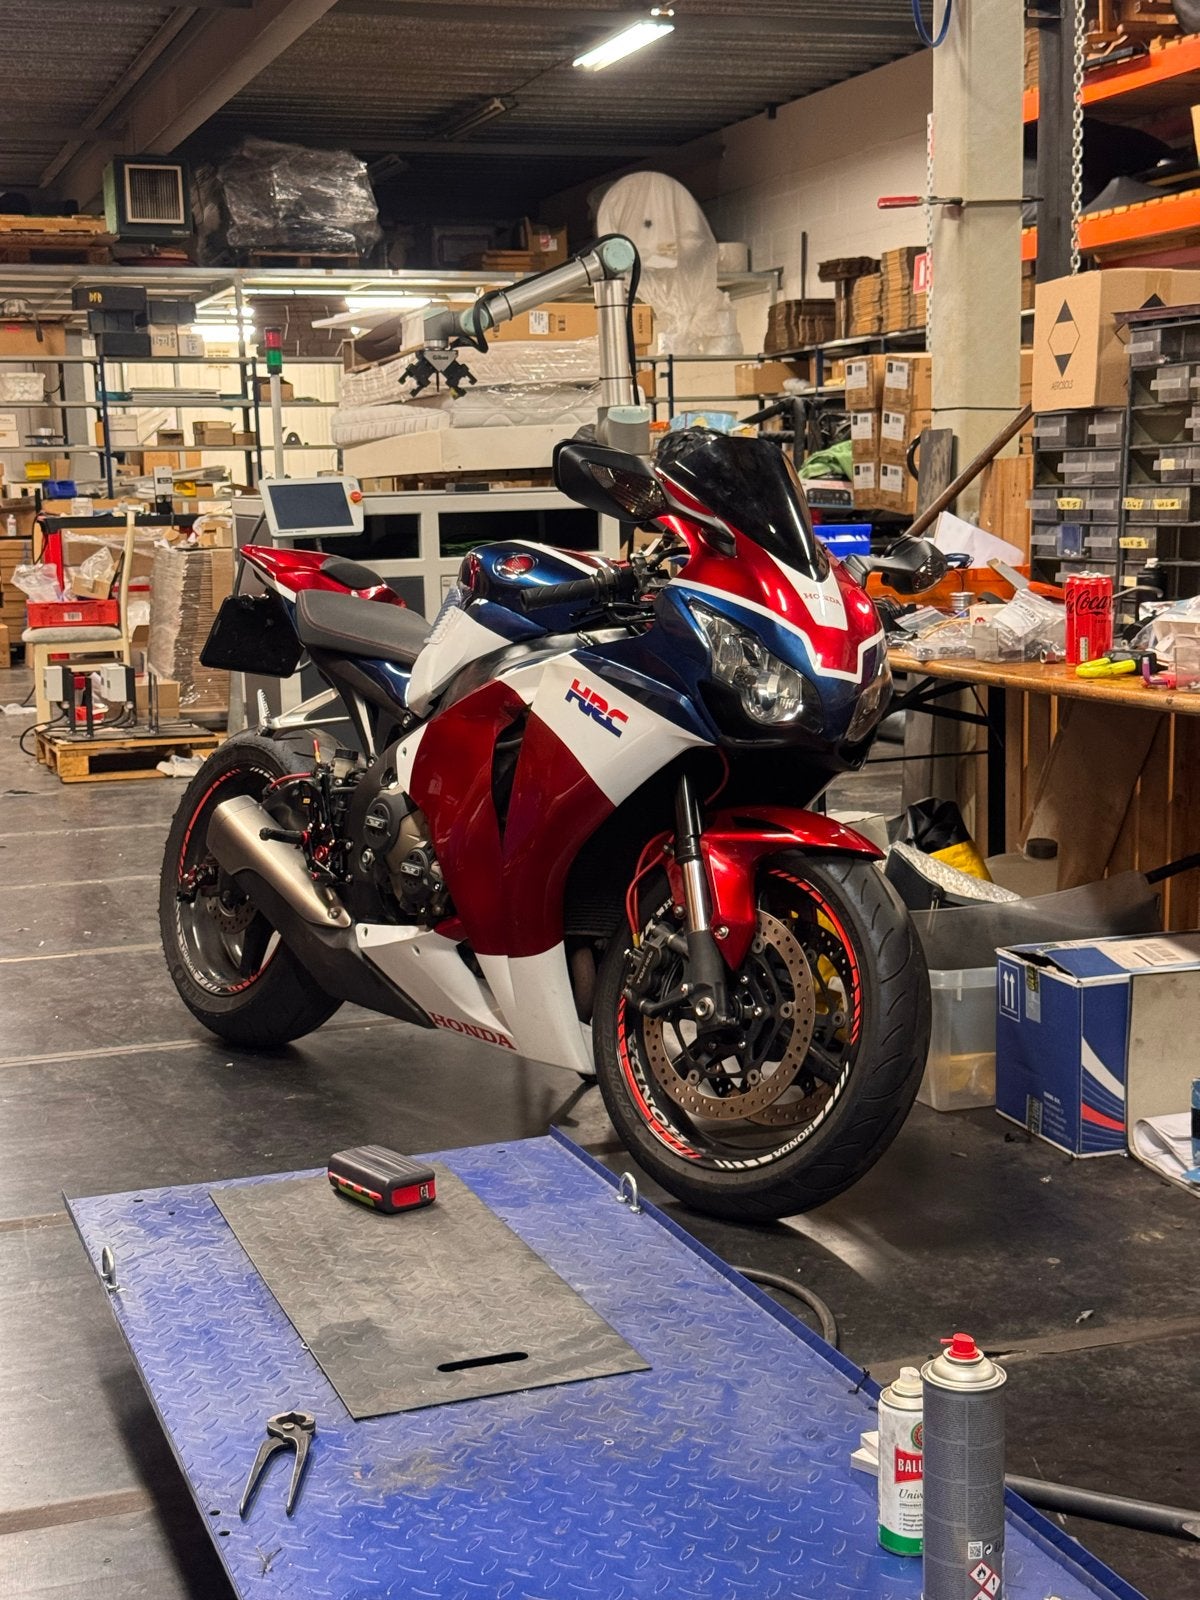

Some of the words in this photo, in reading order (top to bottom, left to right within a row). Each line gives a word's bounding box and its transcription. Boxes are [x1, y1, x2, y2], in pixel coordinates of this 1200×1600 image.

[1076, 590, 1108, 616] Coca
[564, 678, 629, 738] HRC
[636, 951, 654, 985] TOKICO
[428, 1011, 518, 1051] HONDA
[627, 1028, 690, 1143] HONDA
[771, 1122, 815, 1159] HONDA
